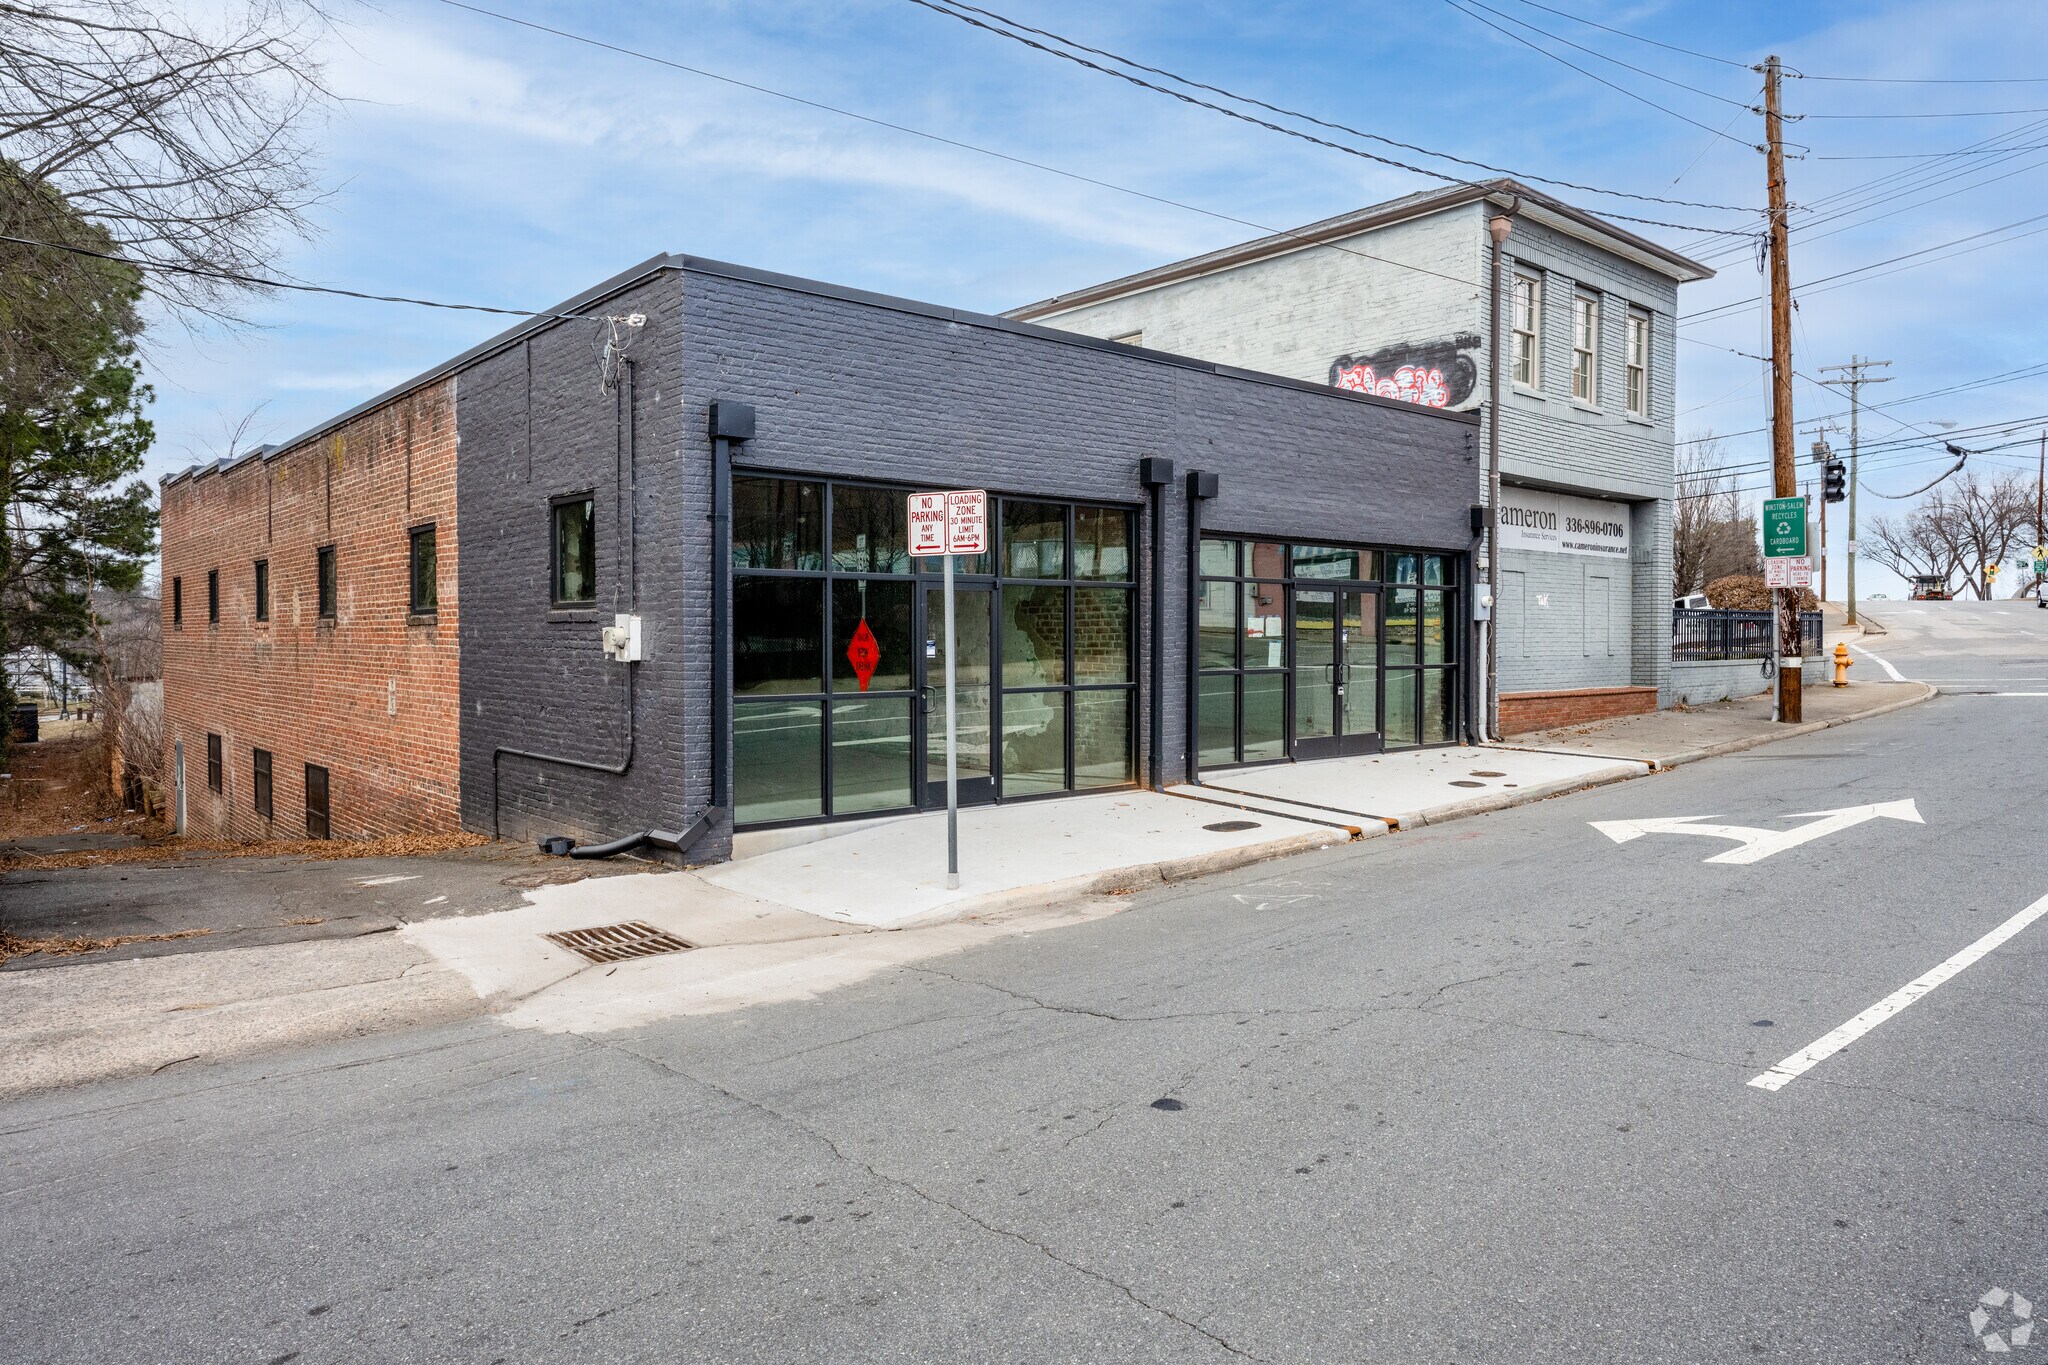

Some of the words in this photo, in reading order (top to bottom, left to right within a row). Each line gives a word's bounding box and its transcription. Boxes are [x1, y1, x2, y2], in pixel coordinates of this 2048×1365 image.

[921, 497, 933, 509] NO
[950, 494, 982, 506] LOADING
[956, 505, 976, 516] ZONE
[1765, 501, 1804, 512] WINSTON-SALEM
[911, 510, 944, 523] PARKING
[950, 517, 958, 525] 30
[960, 516, 983, 525] MINUTE
[1500, 505, 1558, 531] ameron
[1771, 511, 1797, 520] RECYCLES
[921, 524, 934, 533] ANY
[958, 525, 975, 534] LIMIT
[1565, 516, 1624, 538] 336-896-0706
[920, 534, 935, 542] TIME
[953, 534, 980, 543] 6AM-6PM
[1770, 536, 1800, 546] CARDBOARD
[1561, 540, 1628, 555] www.cameroninsurance.net
